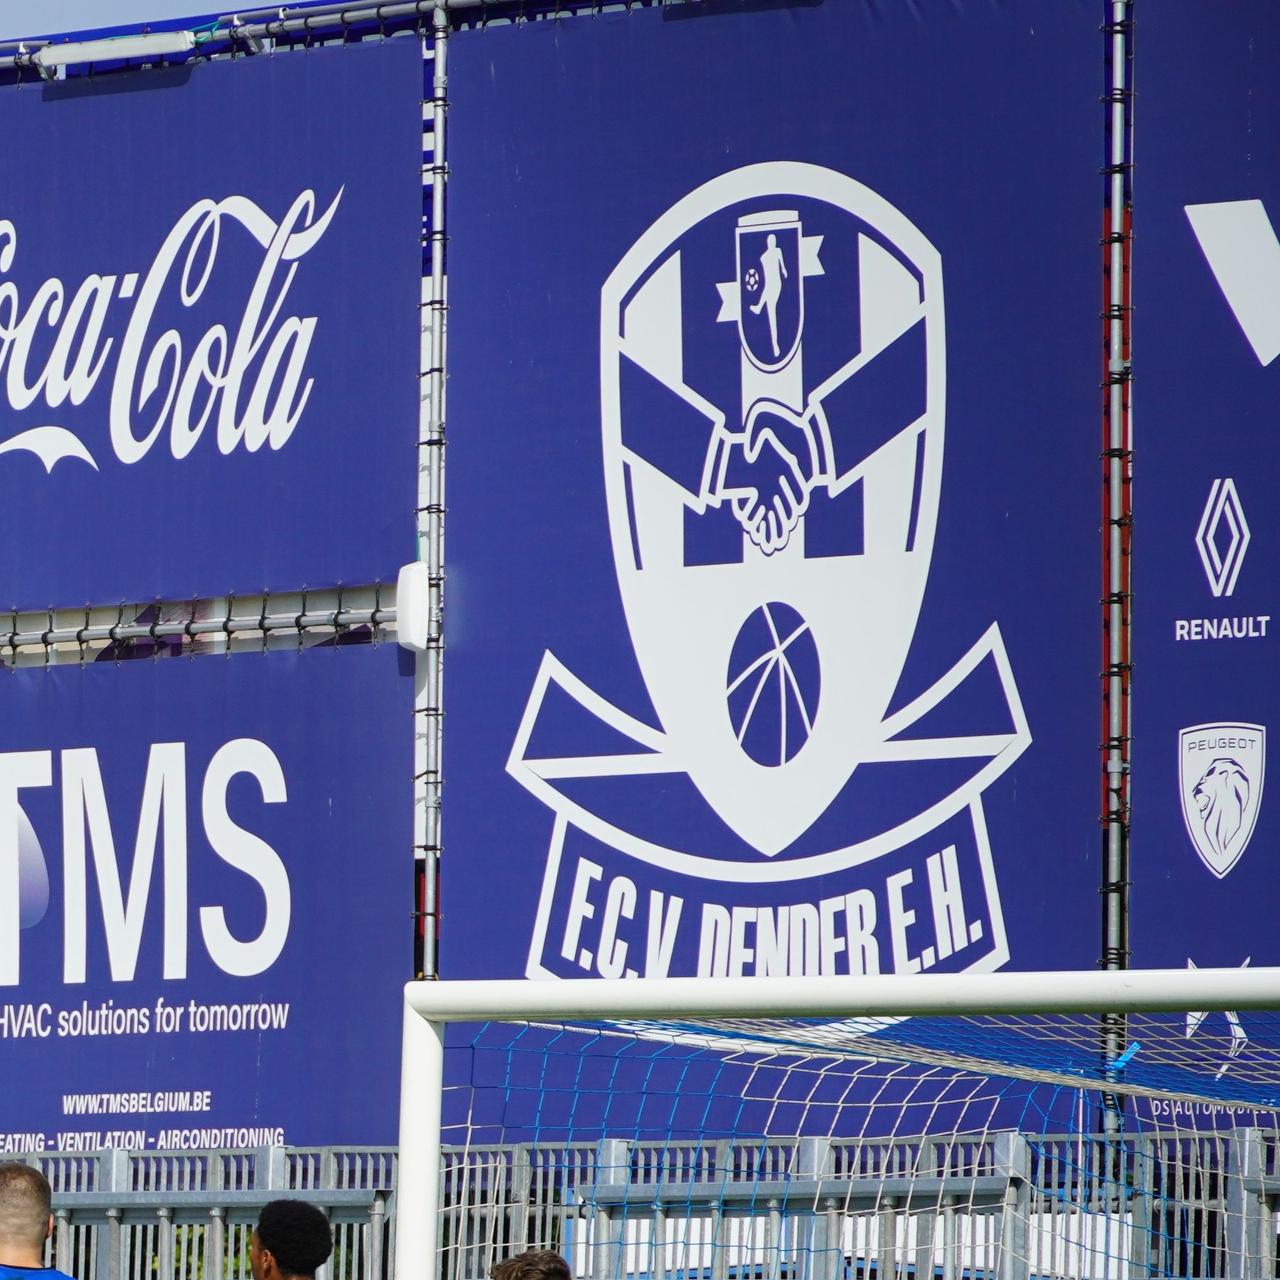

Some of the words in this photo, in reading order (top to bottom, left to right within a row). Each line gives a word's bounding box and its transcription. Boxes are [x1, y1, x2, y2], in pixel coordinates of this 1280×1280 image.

[1175, 616, 1271, 641] RENAULT
[1188, 737, 1257, 753] PEUGEOT
[697, 888, 880, 977] DENDER
[886, 844, 984, 974] E.H.
[58, 1000, 149, 1037] solutions
[156, 998, 183, 1033] for
[189, 1000, 289, 1032] tomorrow
[63, 1091, 211, 1115] WWW.TMSBELGIUM.BE
[57, 1130, 146, 1152] VENTILATION
[157, 1128, 285, 1151] AIRCONDITIONING
